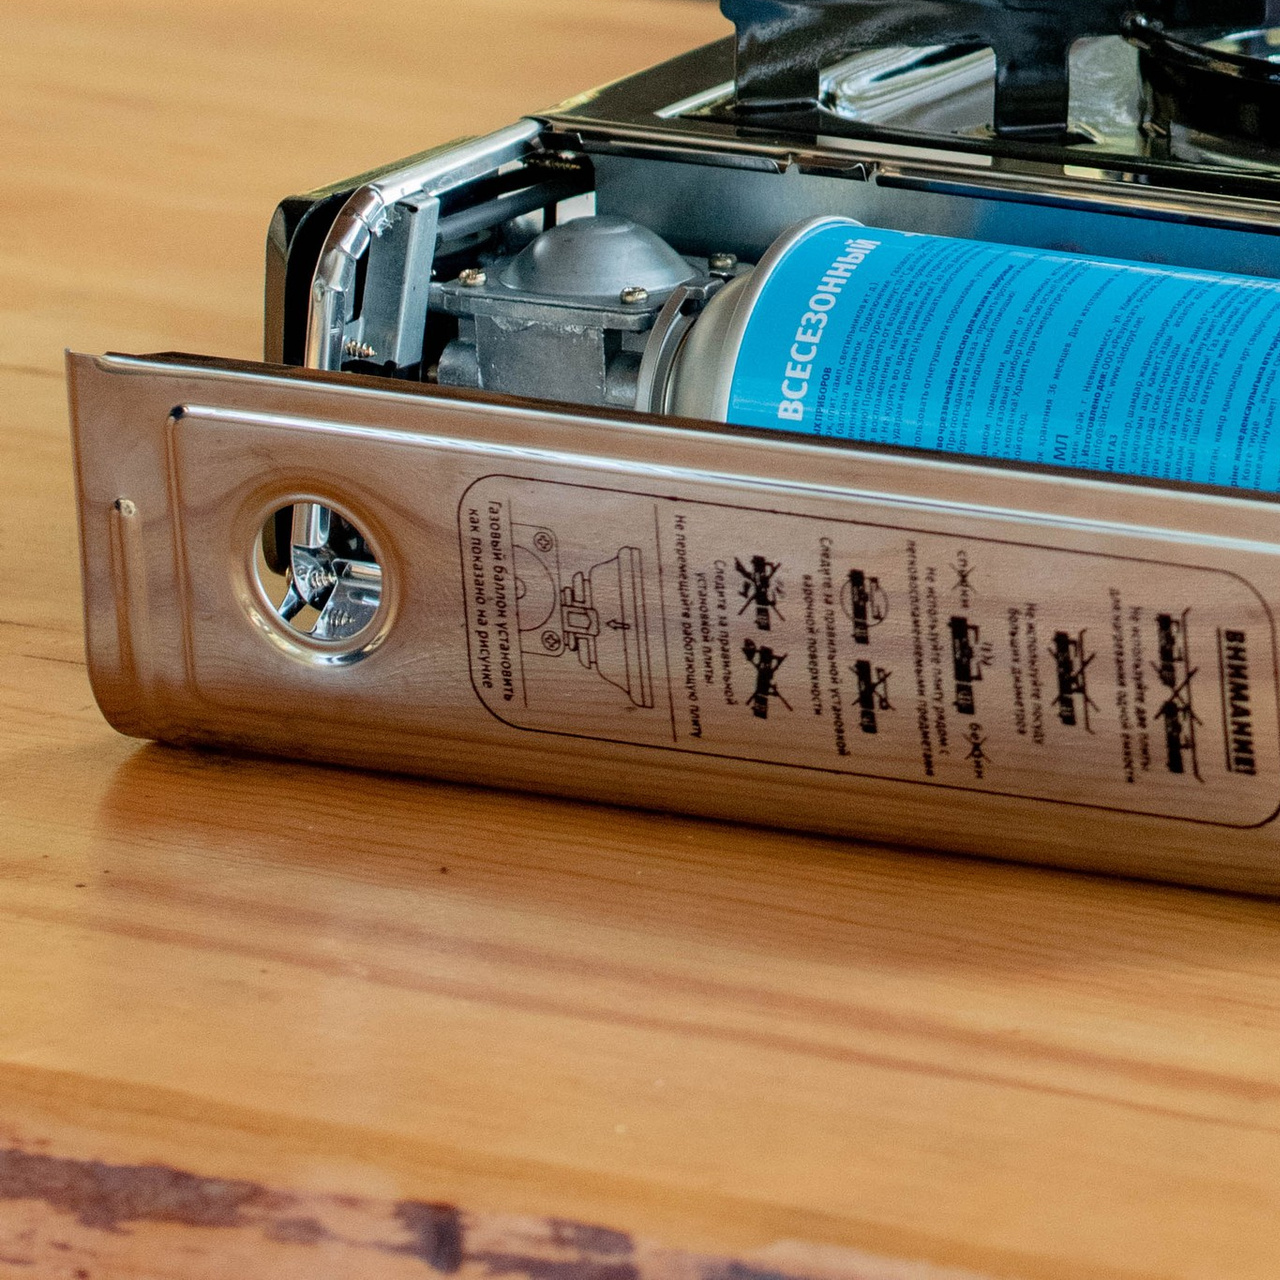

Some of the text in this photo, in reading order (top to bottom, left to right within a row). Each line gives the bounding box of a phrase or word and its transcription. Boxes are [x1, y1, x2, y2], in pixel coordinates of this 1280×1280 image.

[777, 237, 882, 421] ВСЕСЕЗОННЫЙ
[831, 367, 843, 394] ламп,
[837, 303, 867, 366] светильников
[834, 279, 892, 435] баллона колпачок. Подключение
[852, 318, 883, 398] при температуре
[869, 300, 915, 433] воспламенения, нагревания,
[891, 293, 943, 440] ударам ронять! нарушать
[922, 323, 951, 390] огнетушители
[969, 326, 996, 388] медицинской
[994, 304, 1044, 427] газовый прибор полностью
[1100, 349, 1116, 370] ООО
[813, 365, 832, 422] ПРИБОРОВ
[861, 337, 887, 407] Предохранять
[883, 382, 897, 417] курить
[894, 337, 910, 366] время
[937, 333, 970, 435] чрезвычайно опасно
[949, 340, 979, 429] попадании глаза
[985, 328, 1019, 418] помещении, вдали
[1003, 291, 1064, 449] колпачка! Хранить температуре
[1095, 372, 1107, 391] для:
[1038, 397, 1054, 446] хранения
[1046, 382, 1058, 395] 36
[1080, 390, 1102, 457] Изготовлено
[1106, 433, 1118, 453] ГАЗ
[468, 507, 493, 689] как показано на рисунке
[487, 500, 514, 702] Газовый баллон установить
[713, 559, 727, 611] Следите
[818, 536, 833, 589] Следите
[674, 513, 703, 739] Не перемещайте работающую плиту
[694, 571, 711, 643] установкой
[801, 573, 823, 716] варочной поверхности
[925, 585, 940, 664] используйте
[717, 630, 738, 706] правильной
[823, 609, 839, 685] правильной
[1026, 621, 1041, 700] используйте
[829, 687, 851, 757] установкой
[932, 705, 948, 747] рядом
[1010, 665, 1027, 736] диаметров
[1223, 628, 1257, 776] ВНИМАНИЕ!
